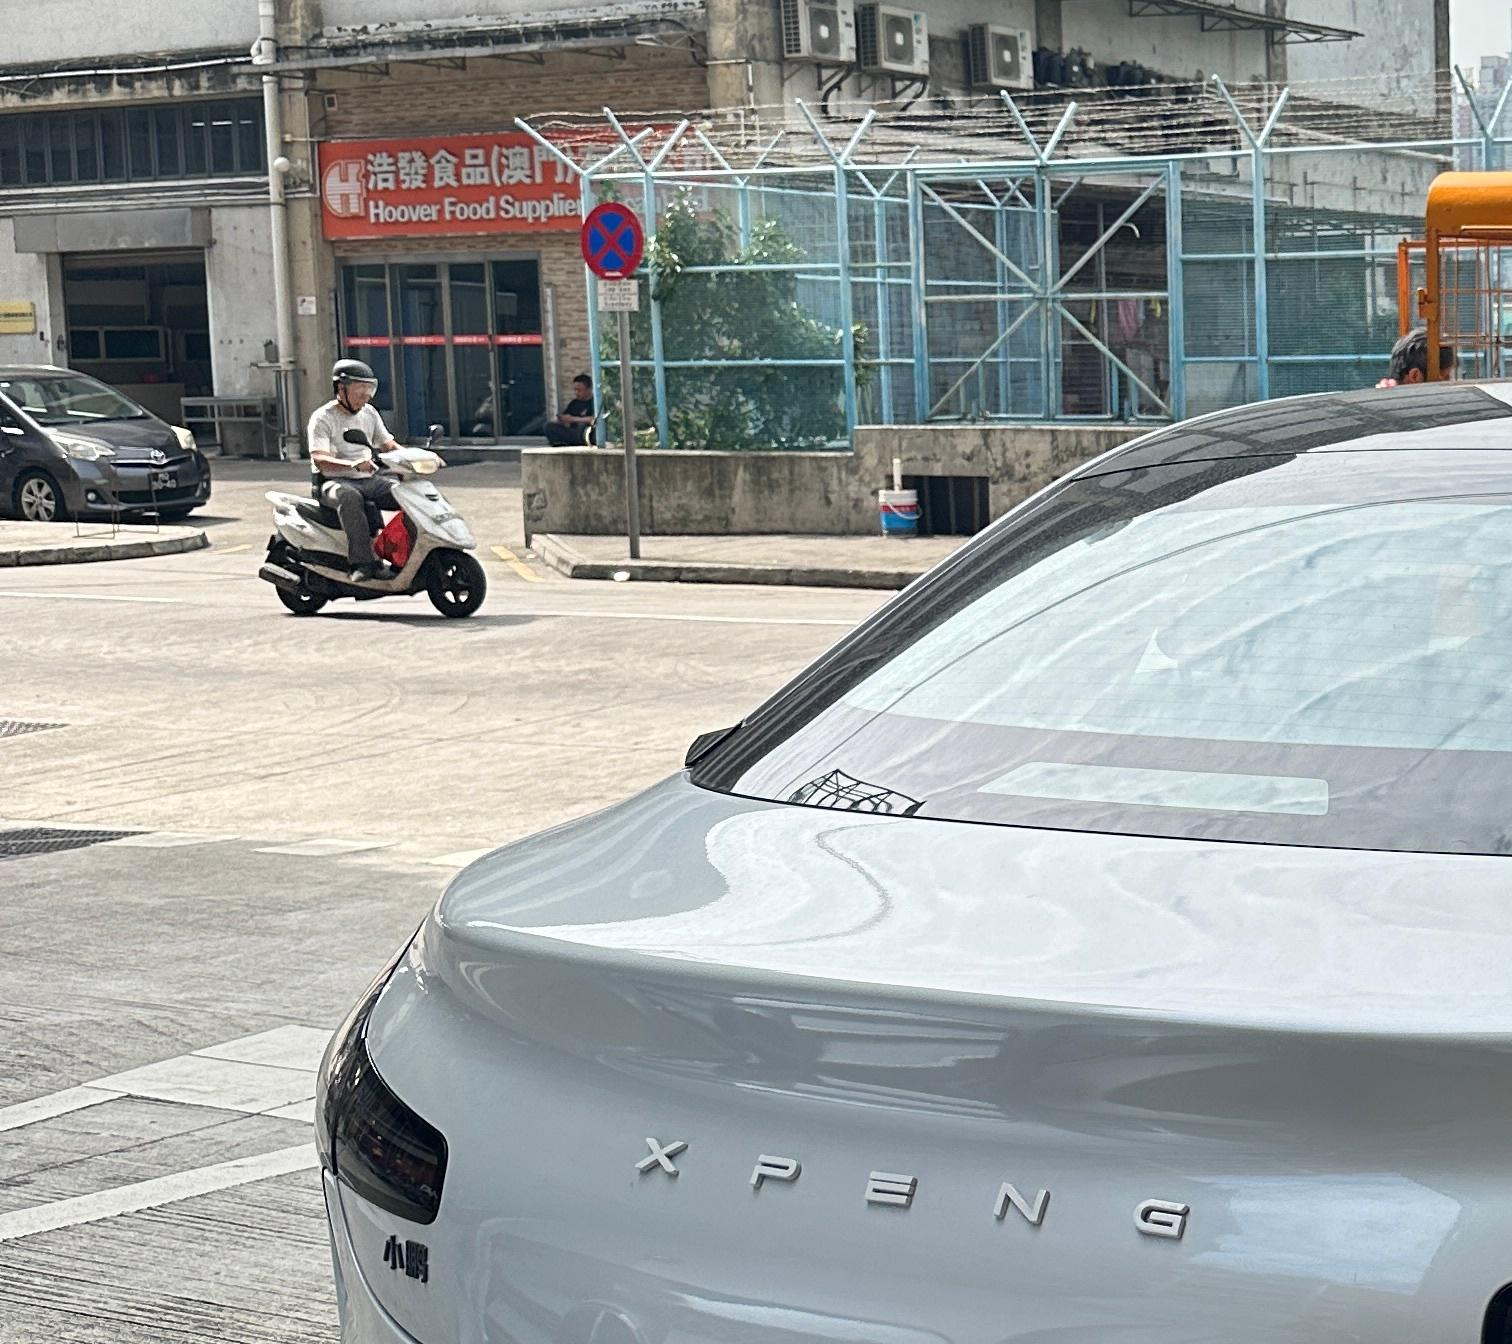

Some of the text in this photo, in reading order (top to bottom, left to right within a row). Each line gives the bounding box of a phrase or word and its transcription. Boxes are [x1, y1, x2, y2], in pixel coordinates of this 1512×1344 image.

[369, 201, 440, 223] Hoover
[443, 197, 496, 220] Food
[635, 1137, 1190, 1240] XPENG
